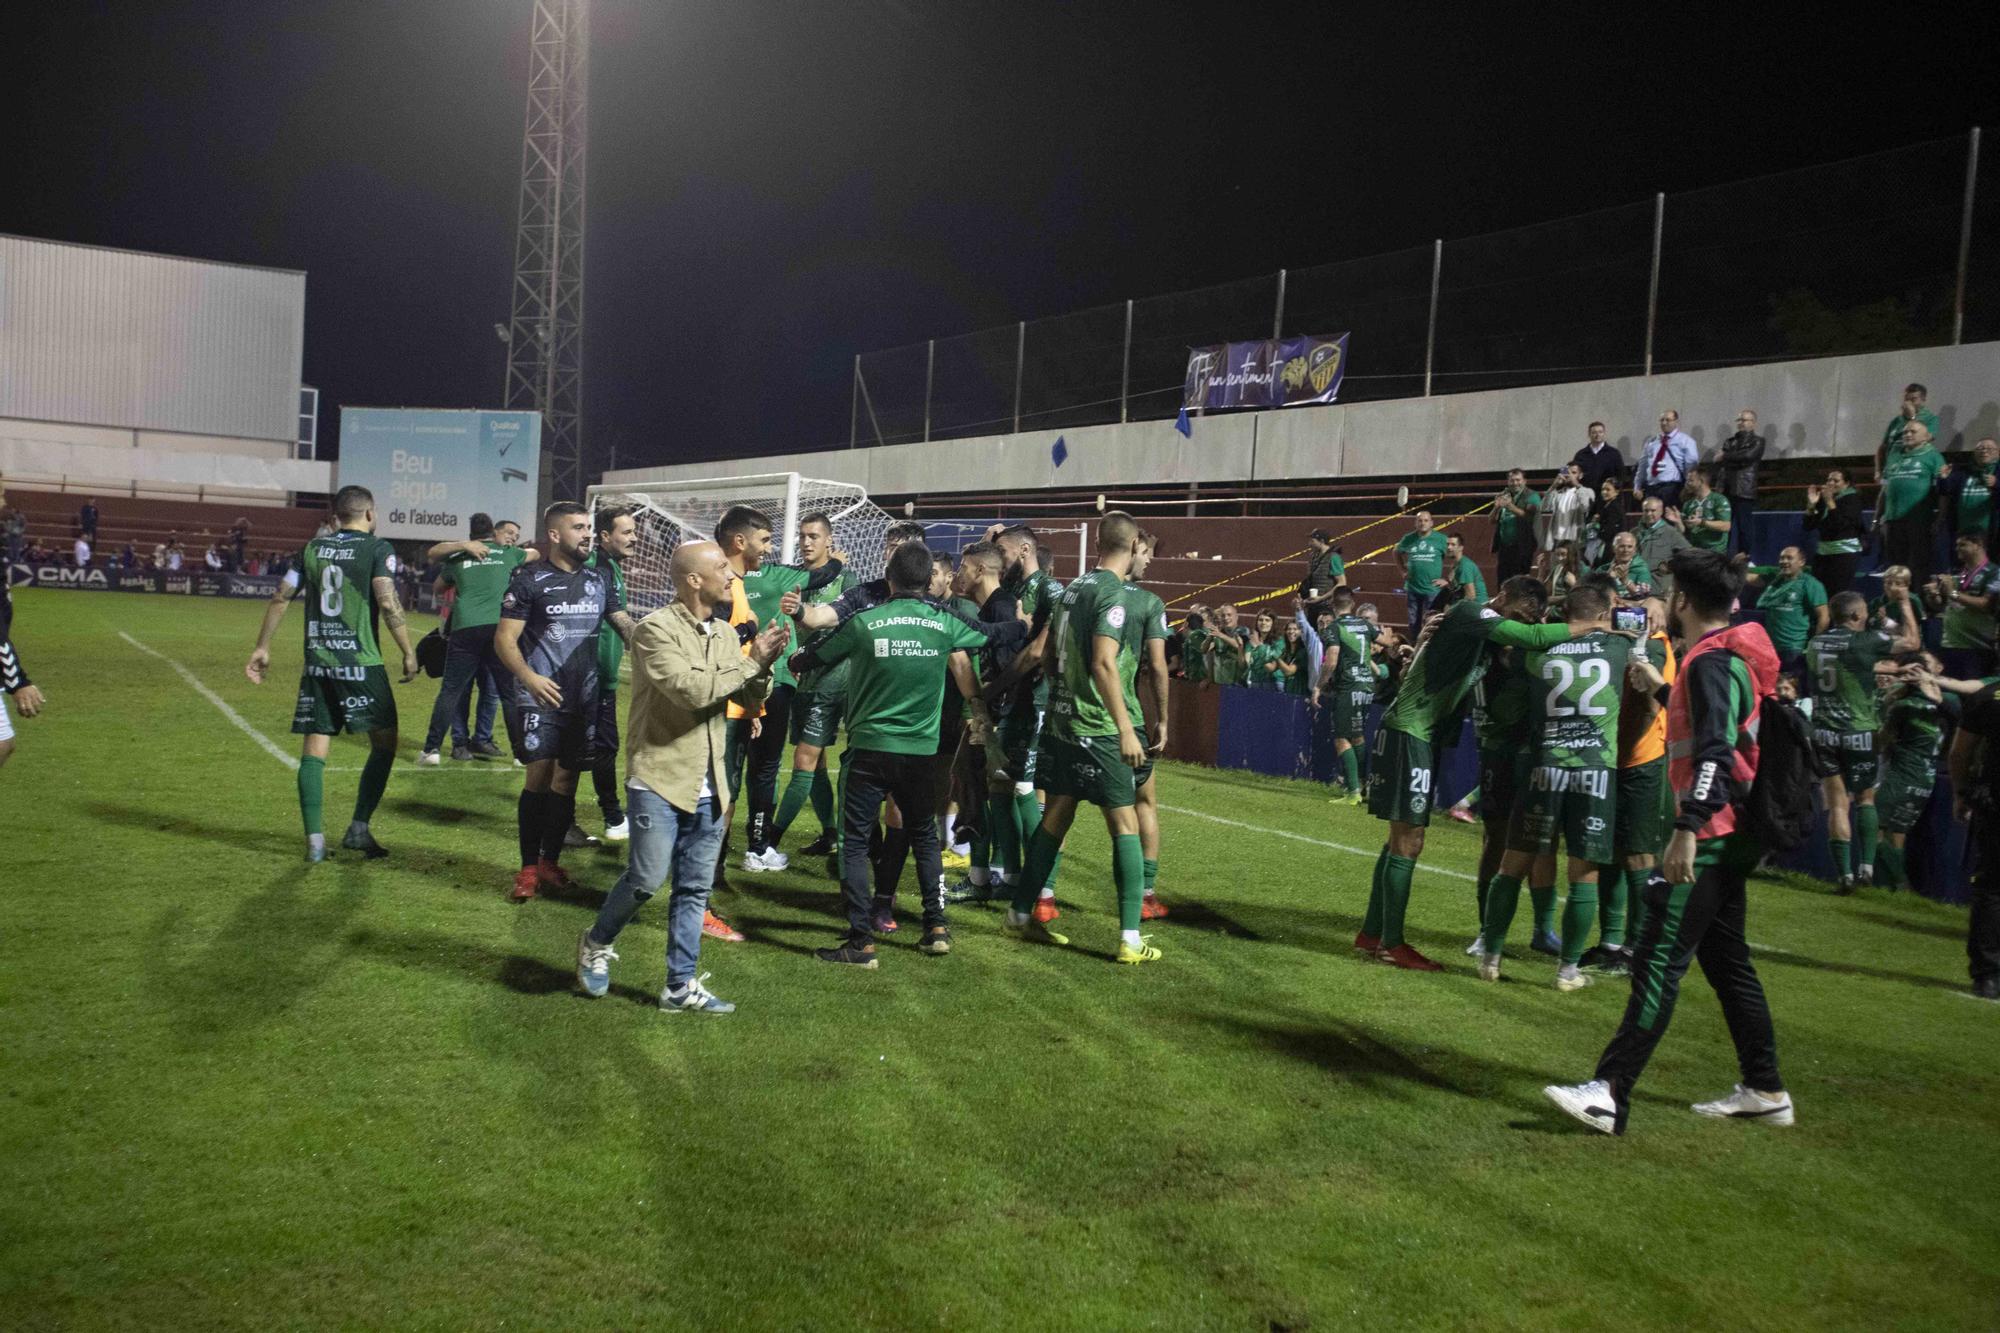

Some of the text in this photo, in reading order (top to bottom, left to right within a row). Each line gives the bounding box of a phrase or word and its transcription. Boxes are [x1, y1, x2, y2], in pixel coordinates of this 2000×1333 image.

[1226, 351, 1284, 400] sentiment
[391, 449, 433, 475] Beu
[390, 478, 448, 506] aigua
[389, 508, 458, 526] de l'aixeta
[37, 566, 108, 583] CMA
[321, 564, 344, 617] 8
[545, 601, 600, 615] columbia
[892, 640, 922, 649] XUNTA
[905, 649, 939, 657] GALICIA
[1356, 633, 1366, 665] 7
[1593, 641, 1605, 653] S.
[1817, 653, 1838, 692] 5
[1542, 658, 1611, 717] 22
[523, 711, 540, 733] 13
[1409, 767, 1431, 794] 20
